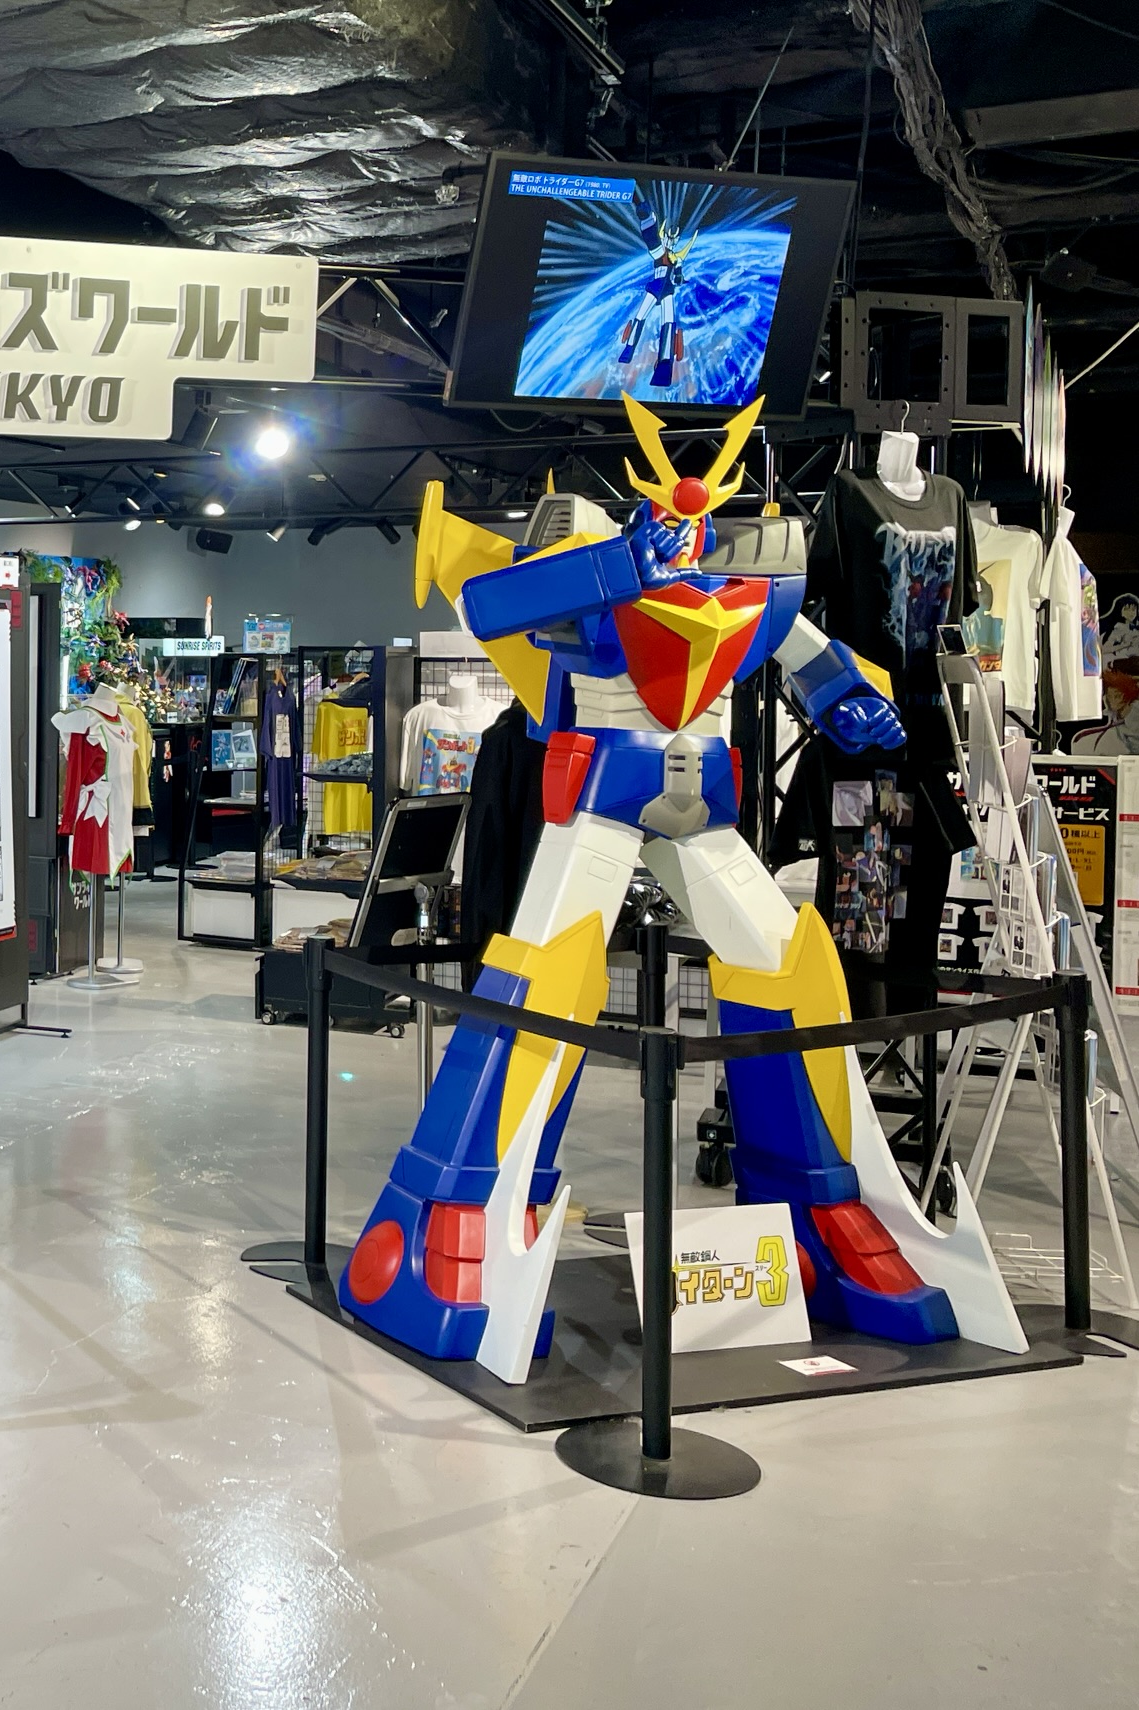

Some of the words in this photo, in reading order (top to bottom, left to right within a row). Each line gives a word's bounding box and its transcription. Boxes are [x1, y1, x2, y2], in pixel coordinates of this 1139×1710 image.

[511, 183, 525, 193] THE
[526, 185, 595, 198] UNCHALLENGEABLE
[596, 189, 621, 200] TRIDER
[621, 192, 632, 200] G7
[176, 641, 200, 651] SUNRISE
[201, 641, 222, 651] SPIRITS
[680, 1249, 720, 1264] 無敵鋼人
